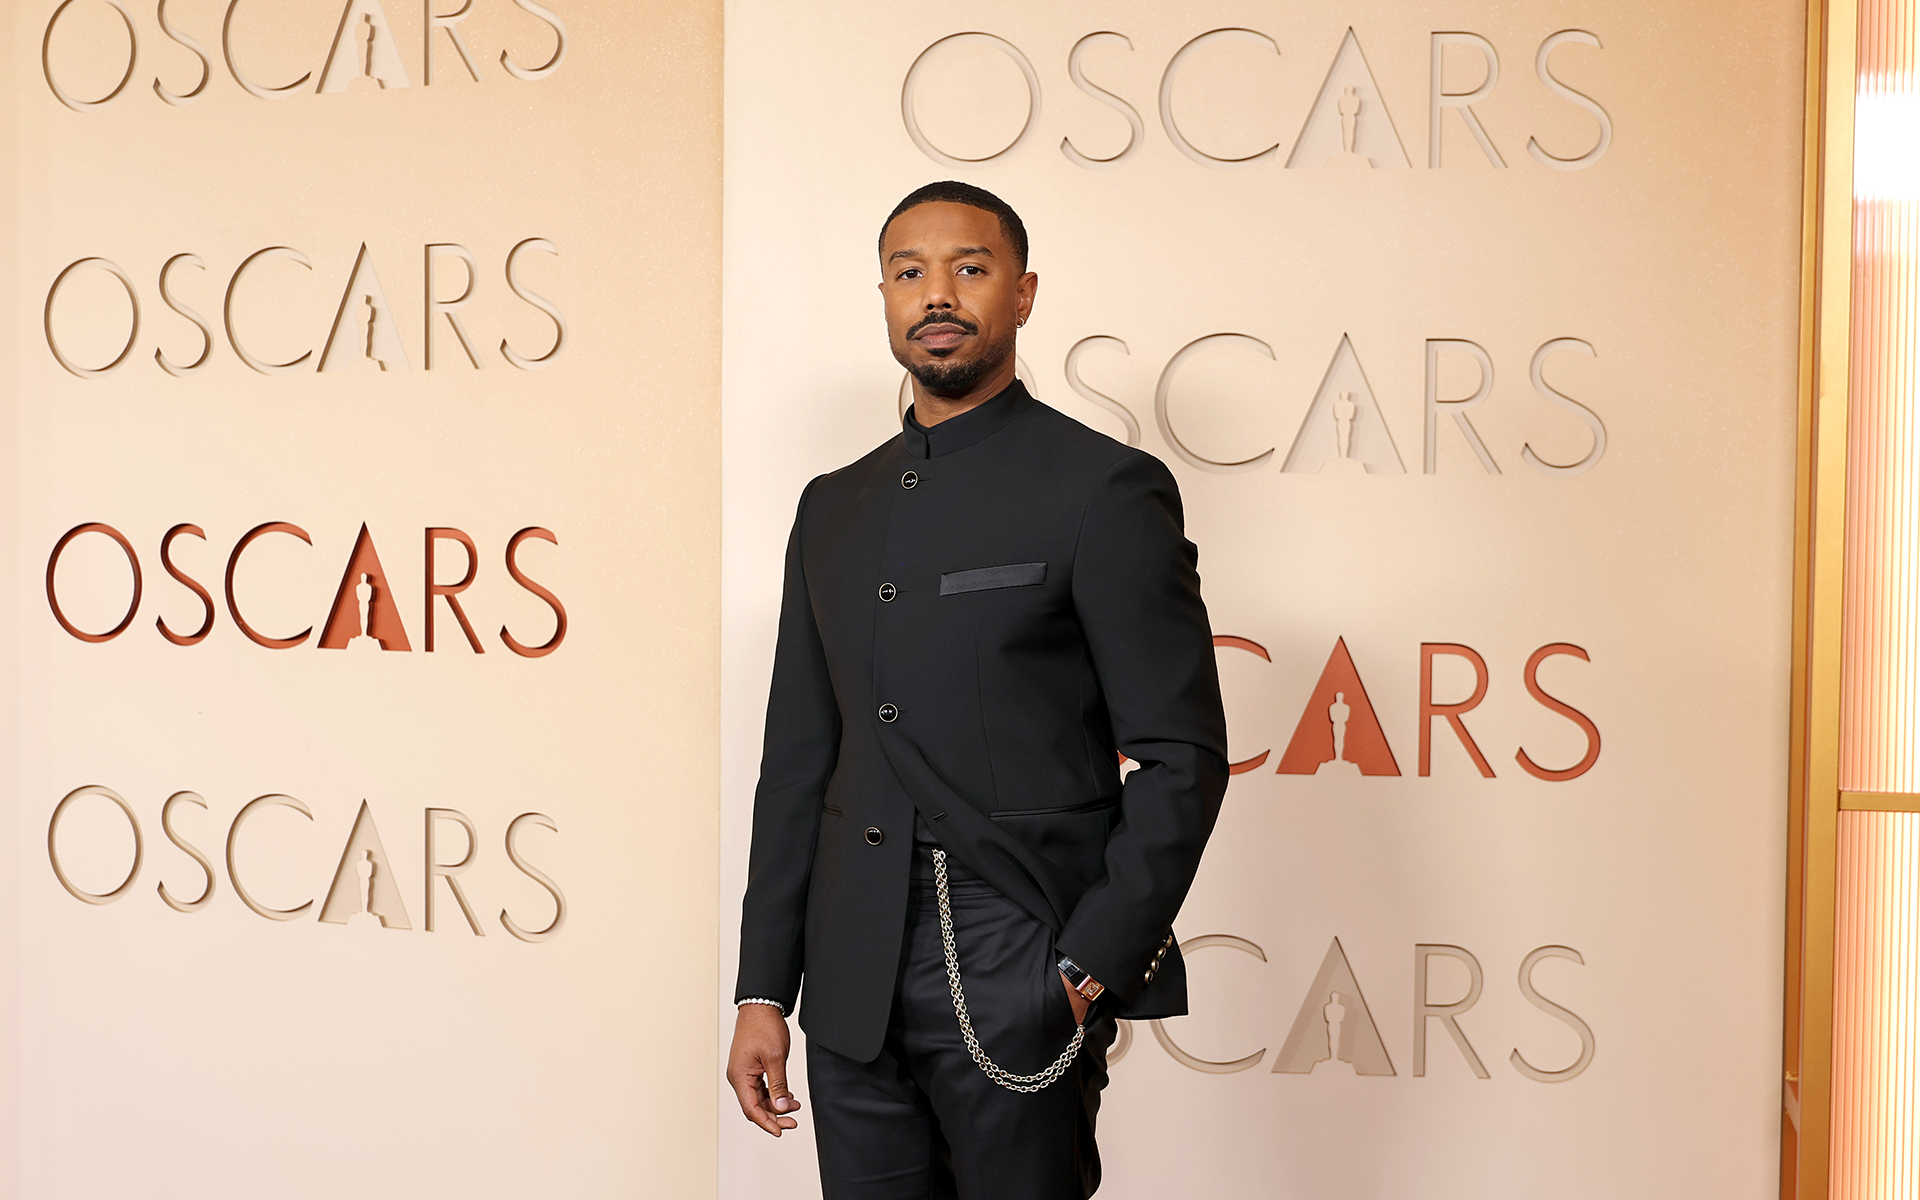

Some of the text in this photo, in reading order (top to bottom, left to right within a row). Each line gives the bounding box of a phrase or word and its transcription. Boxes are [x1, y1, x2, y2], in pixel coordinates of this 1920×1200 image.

[42, 0, 567, 112] OSCARS
[901, 26, 1612, 170] OSCARS
[44, 238, 567, 378] OSCARS
[898, 331, 1607, 475] SCARS
[46, 521, 567, 658] OSCARS
[1118, 635, 1602, 782] ARS
[47, 785, 567, 943] OSCARS
[1107, 934, 1595, 1083] CARS
